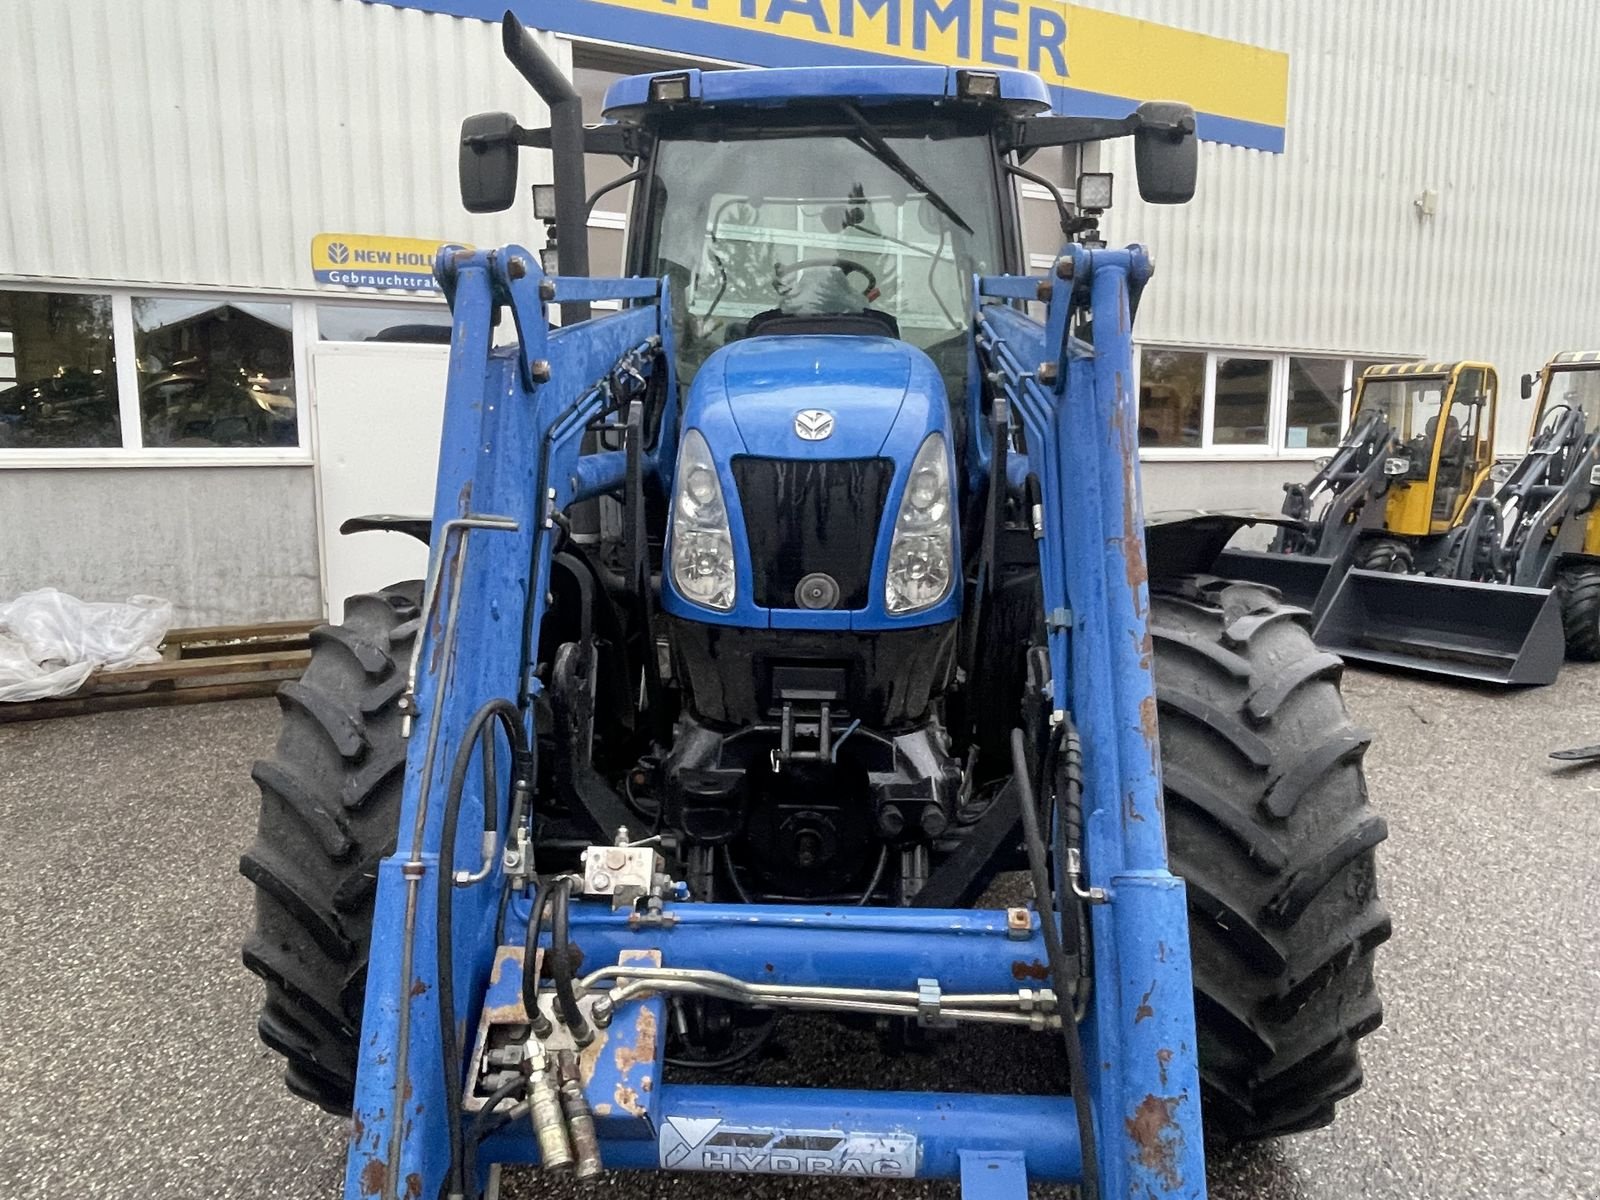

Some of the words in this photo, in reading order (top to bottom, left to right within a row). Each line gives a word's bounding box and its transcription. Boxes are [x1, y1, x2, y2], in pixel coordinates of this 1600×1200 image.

[662, 0, 1069, 77] AMMER
[354, 249, 391, 264] NEW
[702, 1151, 902, 1177] HYDRAC
